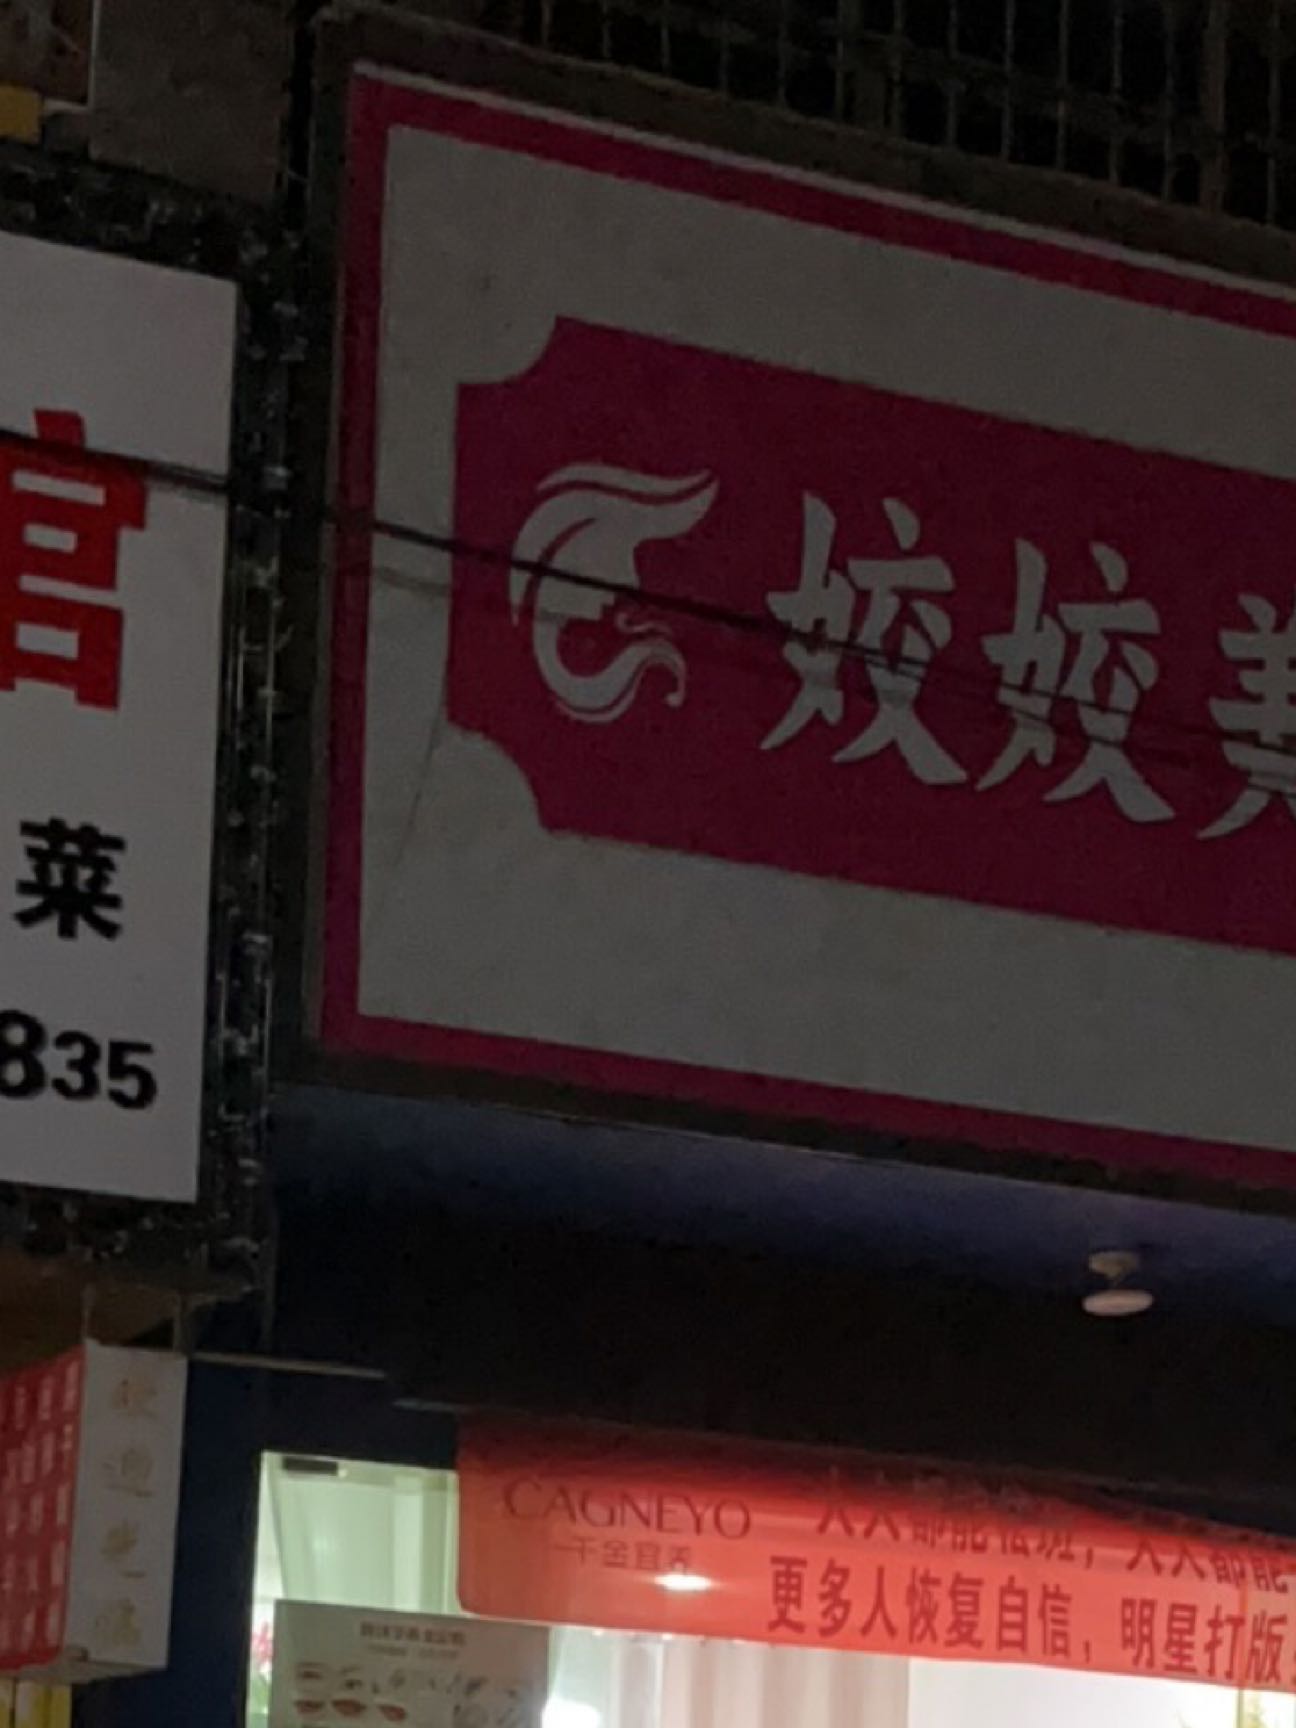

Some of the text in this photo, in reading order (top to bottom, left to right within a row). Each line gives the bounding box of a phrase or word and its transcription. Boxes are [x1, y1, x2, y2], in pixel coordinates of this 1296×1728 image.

[14, 815, 127, 941] 菜
[0, 1009, 158, 1111] 835
[502, 1480, 752, 1541] CAGNEYO
